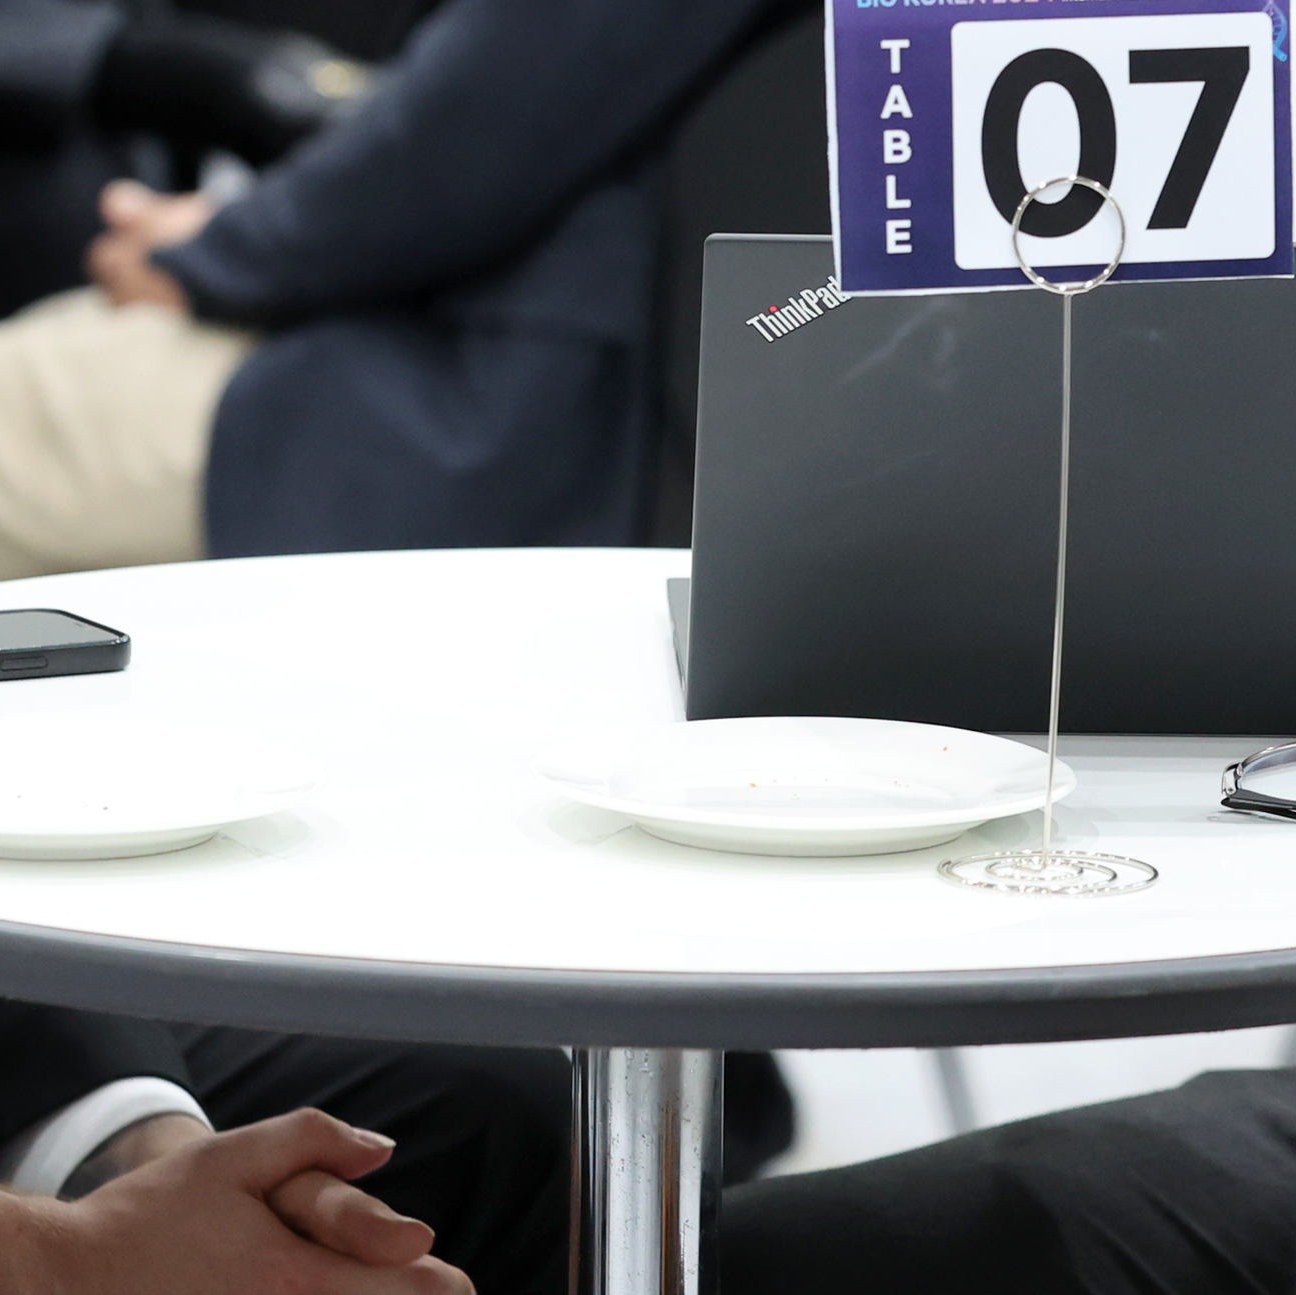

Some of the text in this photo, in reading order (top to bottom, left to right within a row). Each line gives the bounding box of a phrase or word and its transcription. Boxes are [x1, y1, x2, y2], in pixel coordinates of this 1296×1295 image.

[880, 39, 913, 254] TABLE
[981, 45, 1251, 238] 07
[745, 275, 852, 342] ThinkPad
